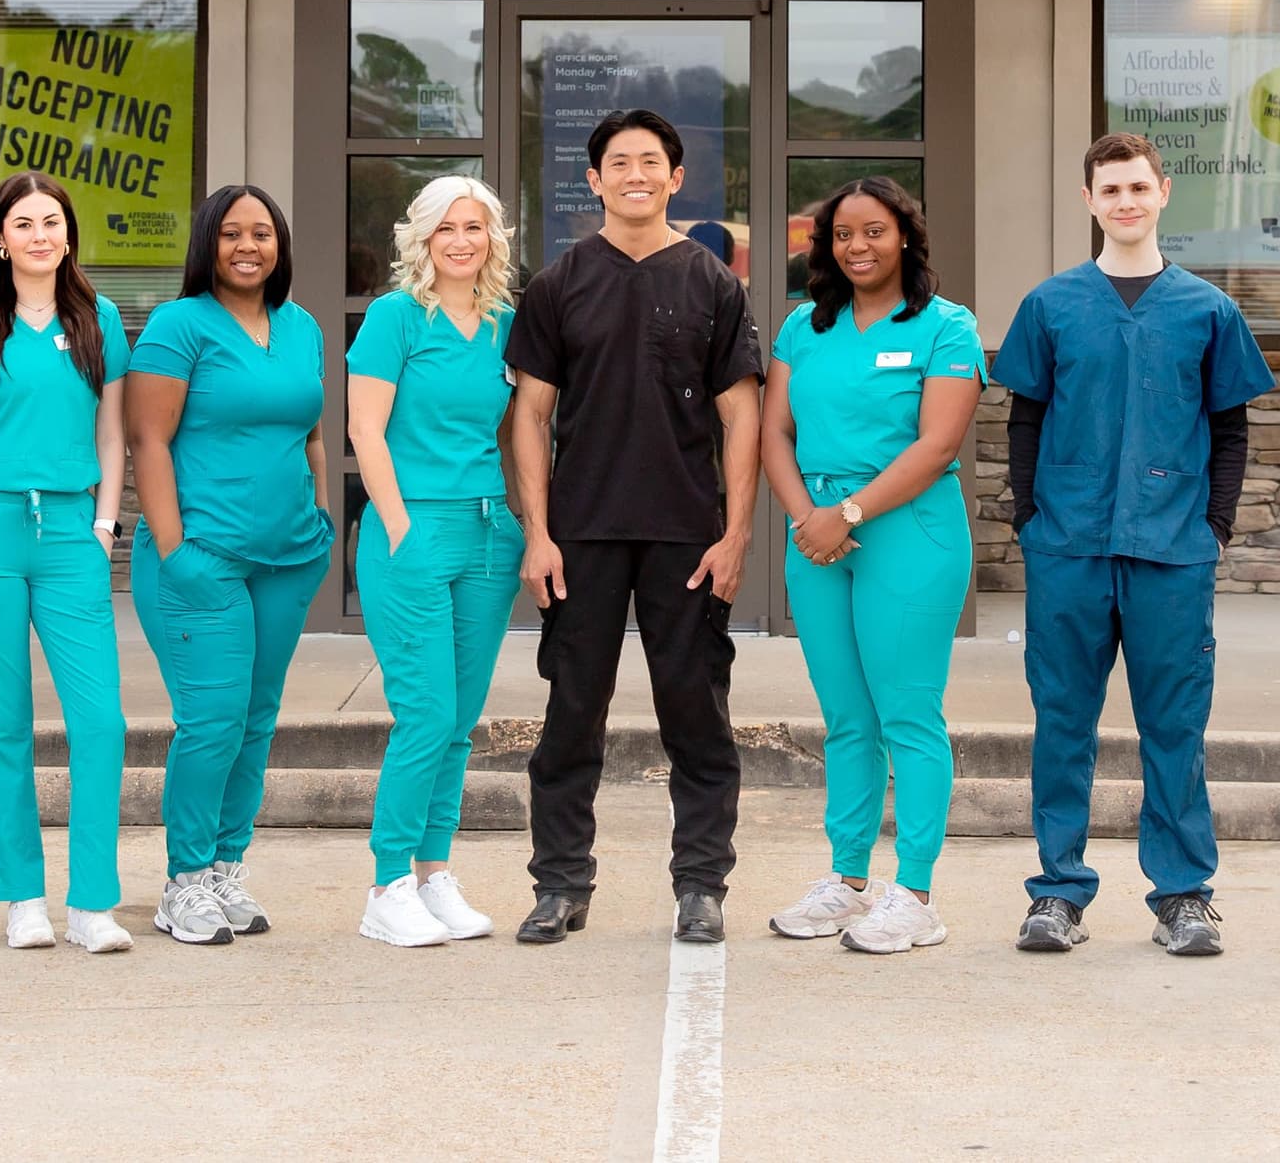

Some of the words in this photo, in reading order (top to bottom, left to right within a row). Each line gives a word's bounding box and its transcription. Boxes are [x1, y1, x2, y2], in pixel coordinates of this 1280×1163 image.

[50, 28, 134, 77] NOW
[555, 54, 586, 62] OFFICE
[588, 54, 619, 62] HOURS
[1122, 49, 1215, 71] Affordable
[555, 67, 596, 78] Monday
[606, 67, 639, 78] Friday
[555, 82, 576, 91] 8am
[1123, 76, 1203, 97] Dentures
[1207, 75, 1222, 97] &
[420, 89, 454, 105] OPEN
[555, 108, 595, 117] GENERAL
[1123, 101, 1200, 129] Implants
[1199, 102, 1233, 129] just
[1154, 132, 1196, 149] even
[1174, 153, 1267, 176] affordable.
